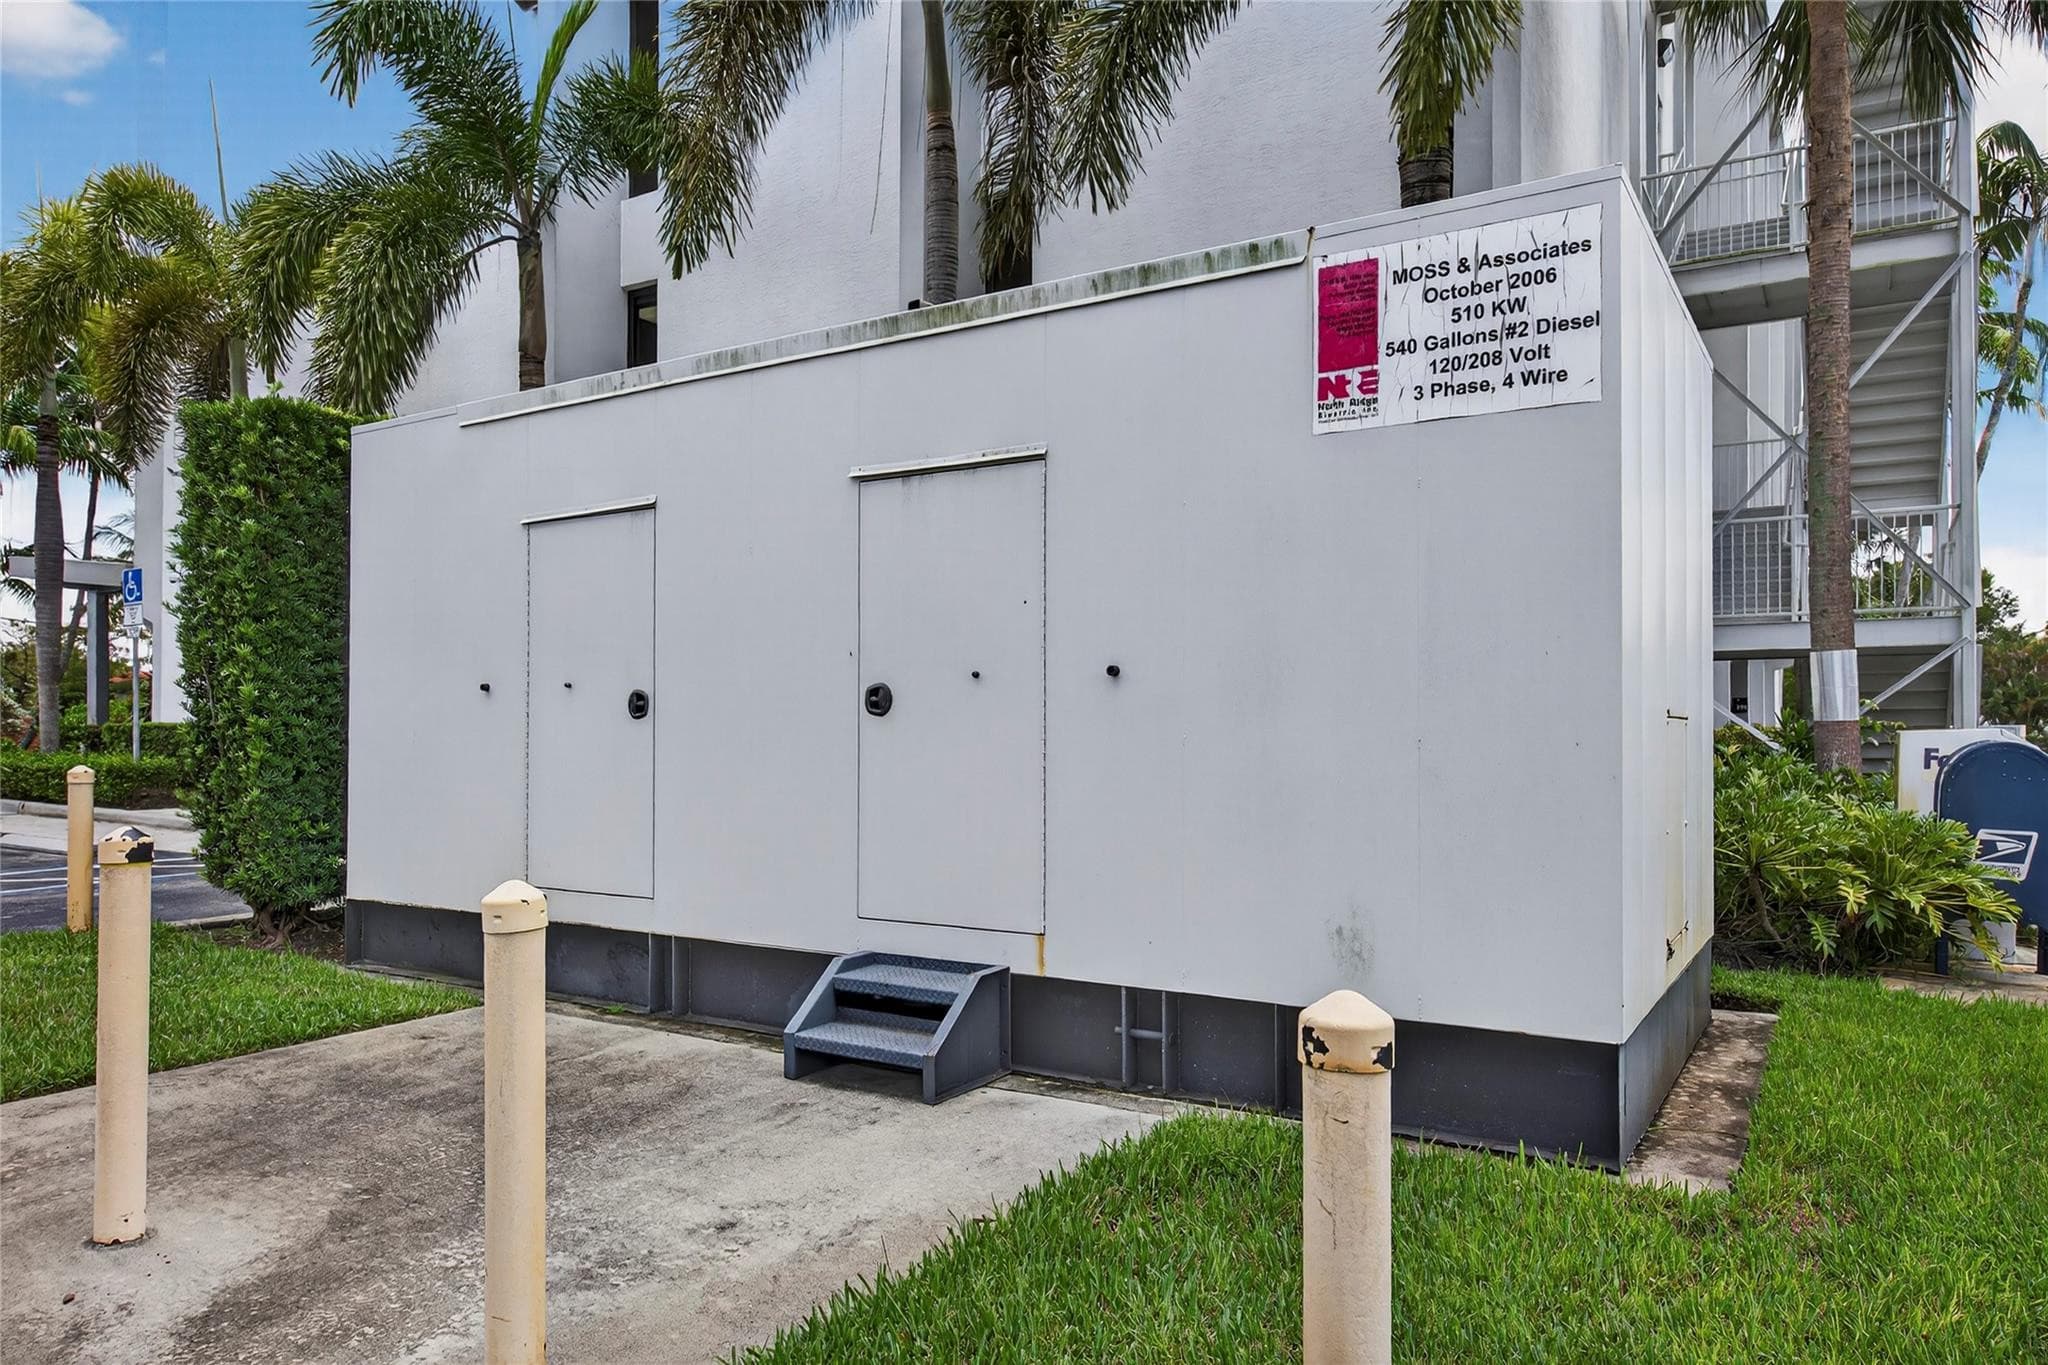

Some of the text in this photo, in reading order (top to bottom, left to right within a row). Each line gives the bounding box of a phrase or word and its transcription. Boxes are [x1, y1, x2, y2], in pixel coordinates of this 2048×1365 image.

[1393, 239, 1592, 285] MOSS & Associates
[1425, 268, 1557, 303] October 2006
[1451, 297, 1527, 324] 510 KW
[1385, 311, 1600, 357] 540 Gallons #2 Diesel
[1429, 344, 1550, 374] 120/208 Volt
[1414, 367, 1568, 401] 3 Phase, 4 Wire
